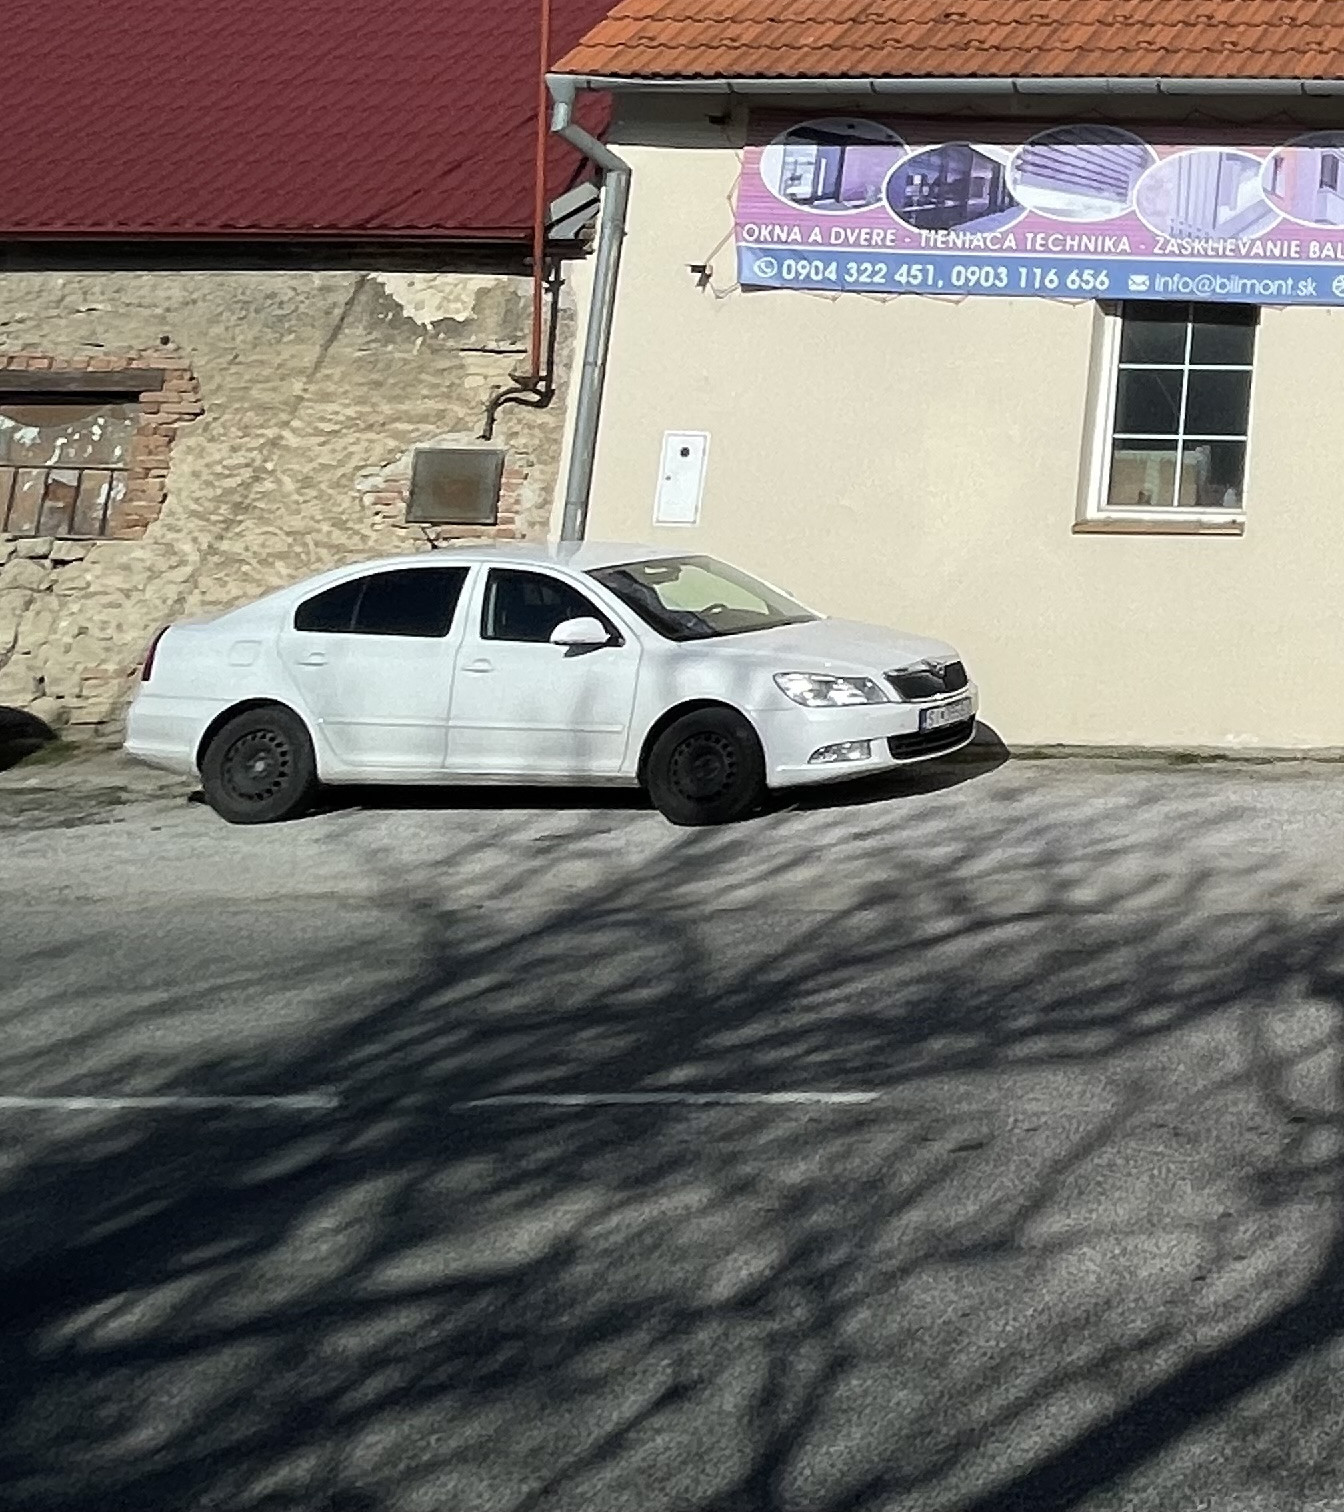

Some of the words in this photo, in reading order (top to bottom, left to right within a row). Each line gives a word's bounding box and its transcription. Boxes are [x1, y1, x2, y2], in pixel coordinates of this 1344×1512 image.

[743, 223, 801, 242] OKNA
[808, 227, 823, 243] A
[830, 227, 897, 246] DVERE
[918, 230, 1016, 250] TIENIACA
[1025, 232, 1131, 252] TECHNIKA
[1153, 236, 1301, 258] ZASKLIEVANIE
[782, 259, 837, 281] 0904
[844, 262, 888, 283] 322
[894, 264, 944, 288] 451,
[951, 265, 1008, 288] 0903
[1019, 266, 1059, 289] 116
[1066, 268, 1110, 290] 656
[1155, 273, 1318, 296] info@bilmont.sk
